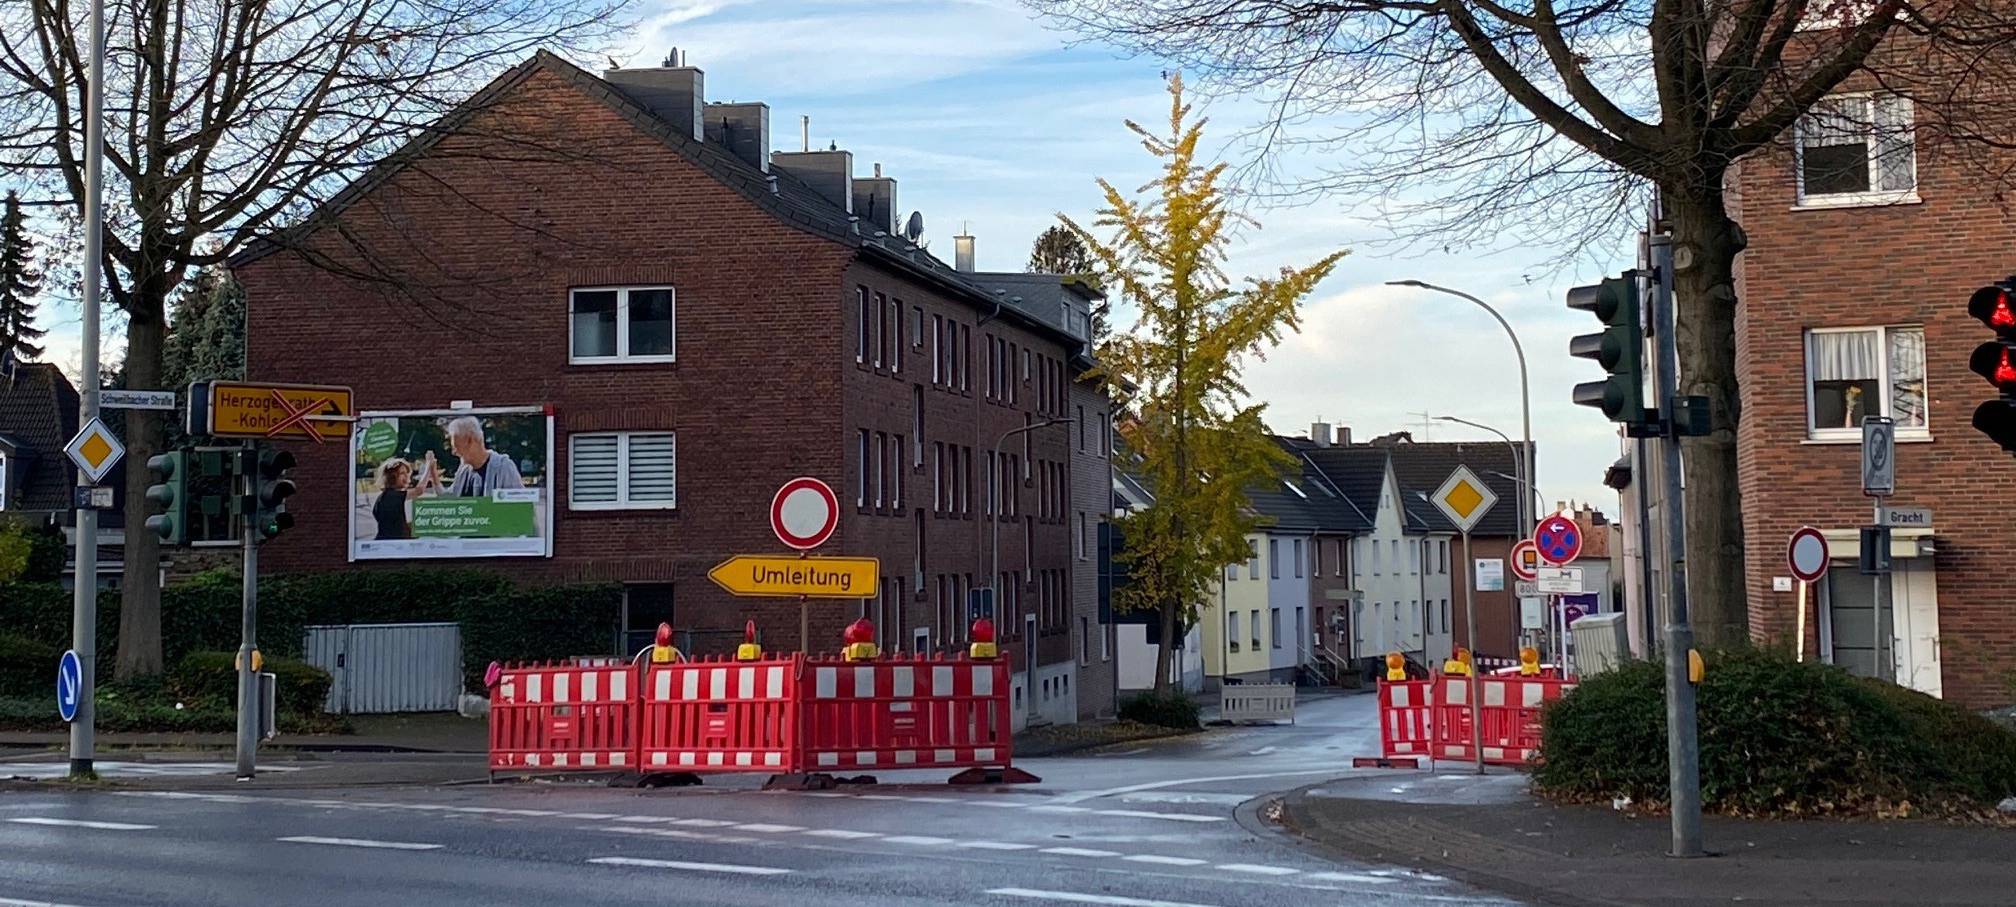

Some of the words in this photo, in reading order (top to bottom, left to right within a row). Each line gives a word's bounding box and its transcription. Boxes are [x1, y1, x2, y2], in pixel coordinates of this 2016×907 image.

[415, 506, 456, 516] Kommen
[458, 506, 473, 515] Sie
[415, 517, 430, 526] der
[431, 516, 462, 527] Grippe
[463, 516, 491, 525] zuvor.
[1890, 512, 1923, 523] Gracht
[753, 565, 851, 591] Umleitung
